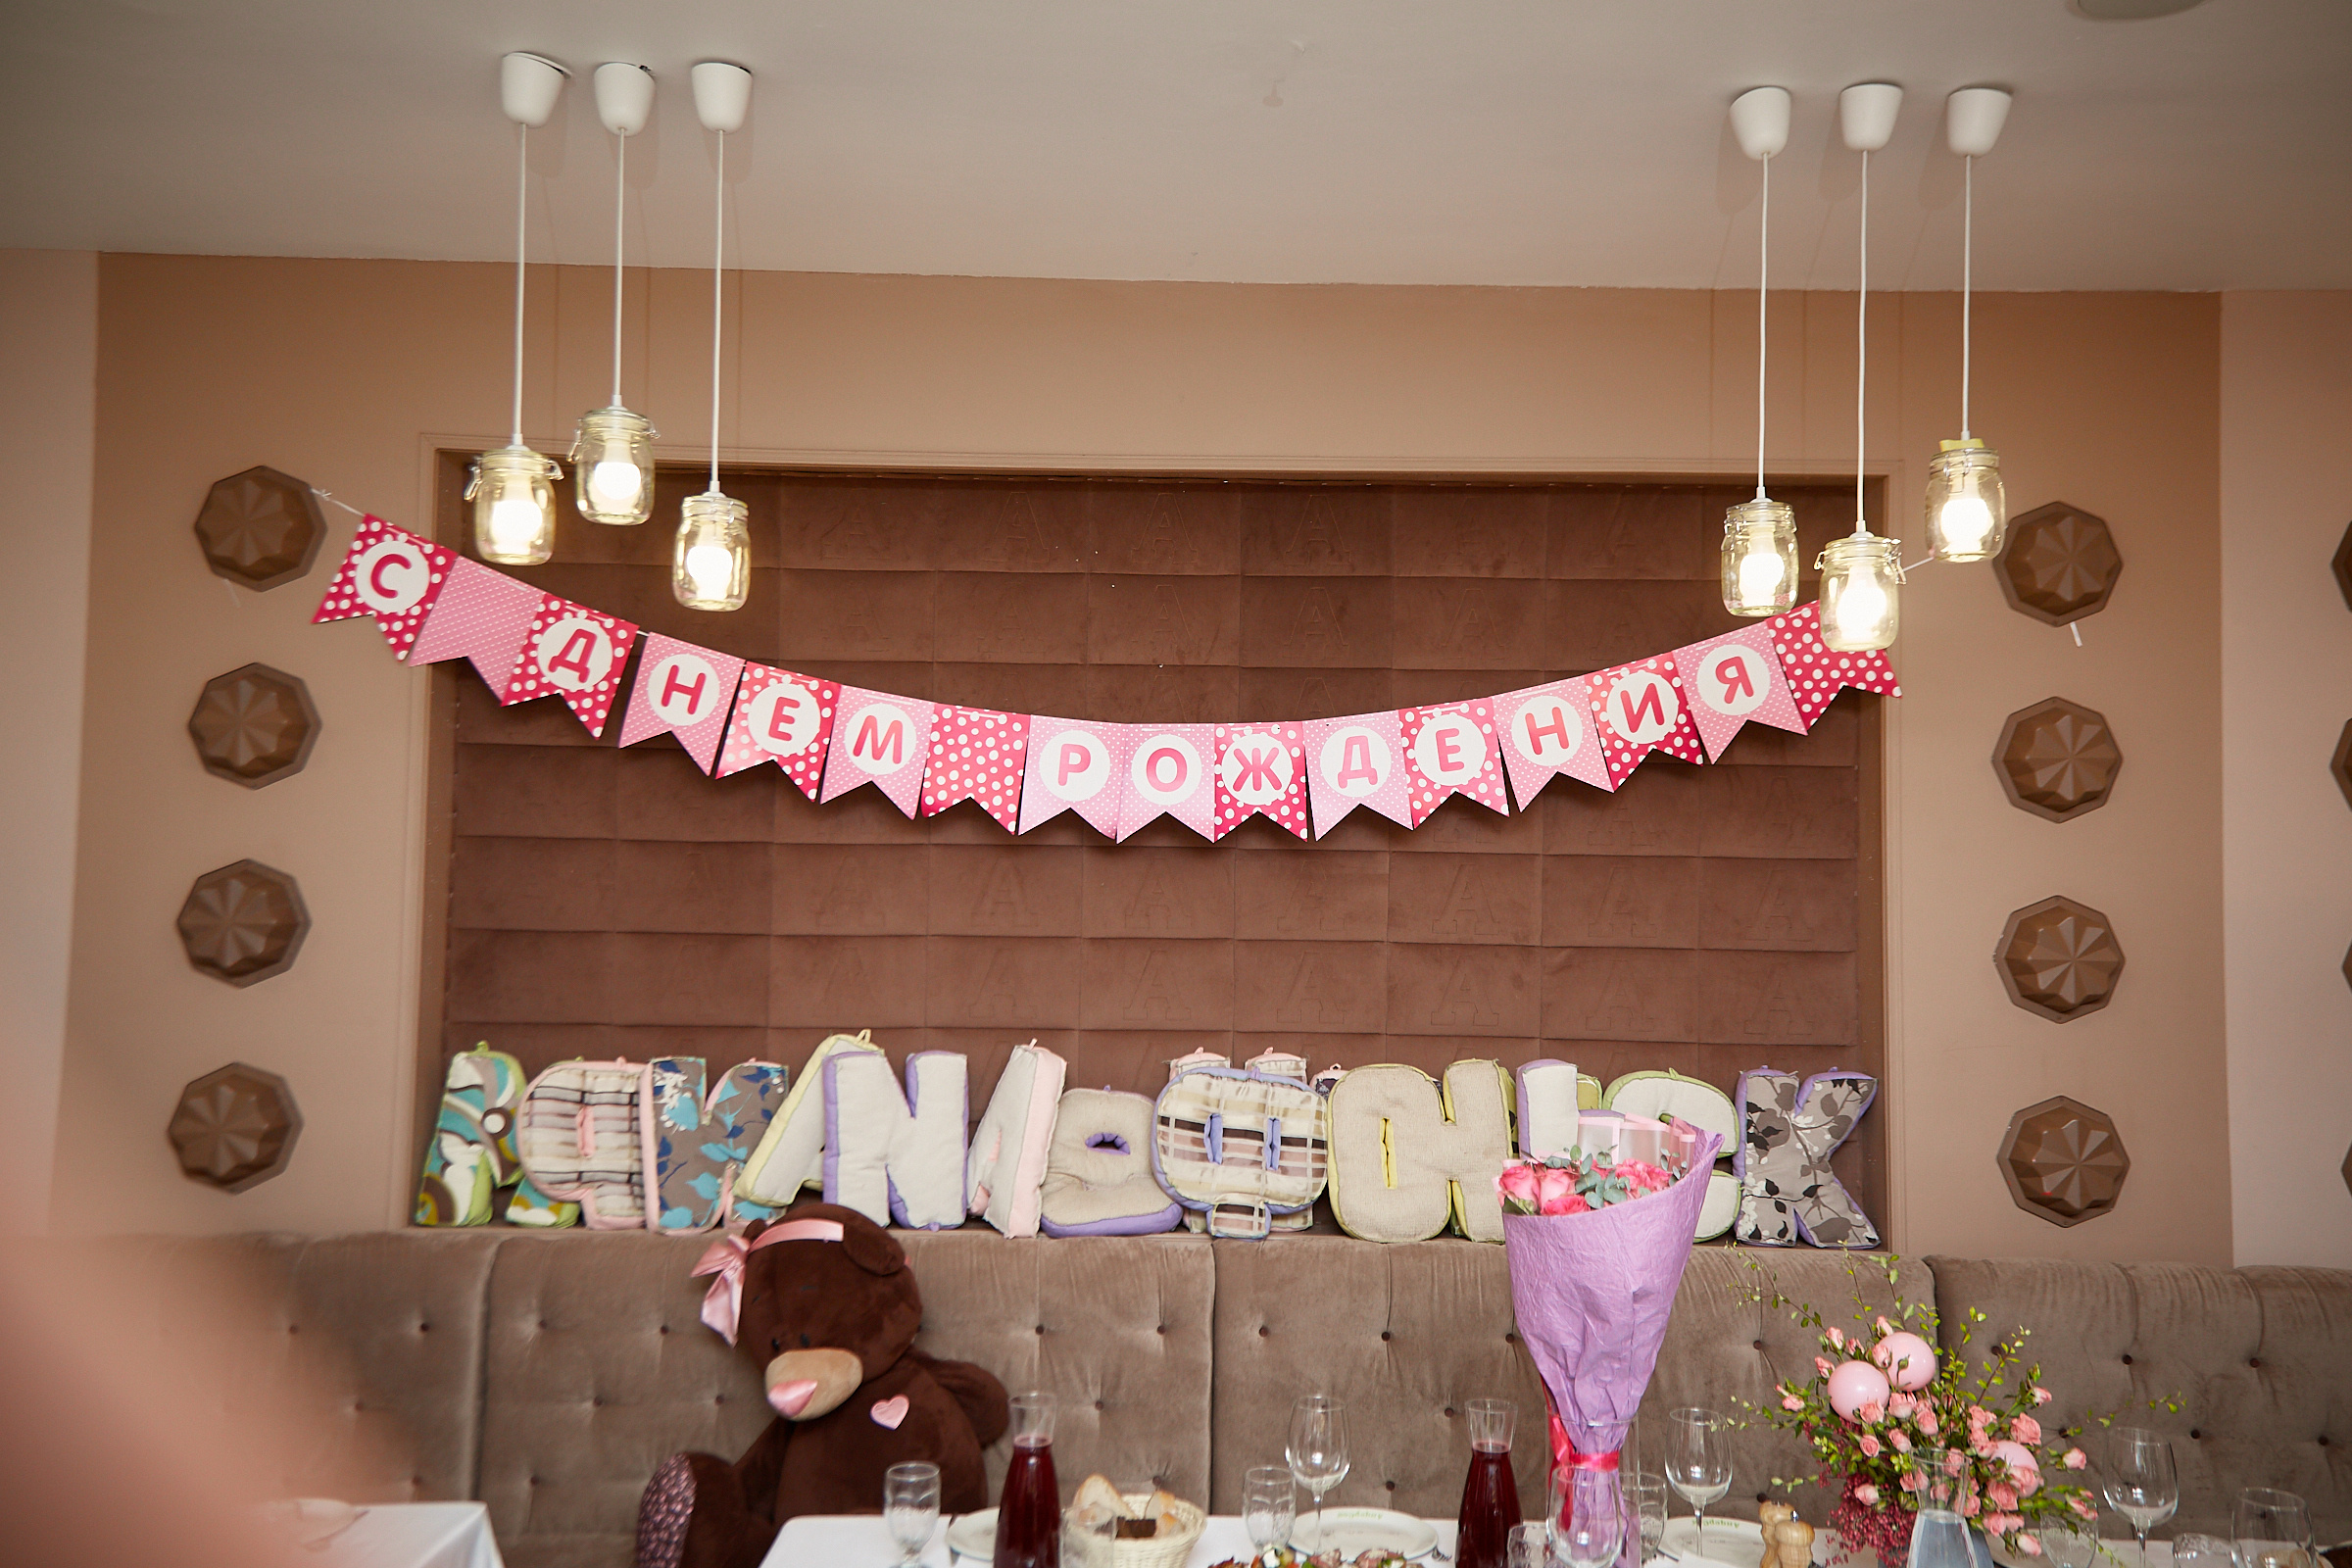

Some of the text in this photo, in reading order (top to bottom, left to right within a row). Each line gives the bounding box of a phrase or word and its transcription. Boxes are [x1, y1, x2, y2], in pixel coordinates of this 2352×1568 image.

[369, 553, 413, 600] С
[547, 616, 905, 765] ДНЕМ
[1056, 654, 1754, 792] РОЖДЕНИЯ
